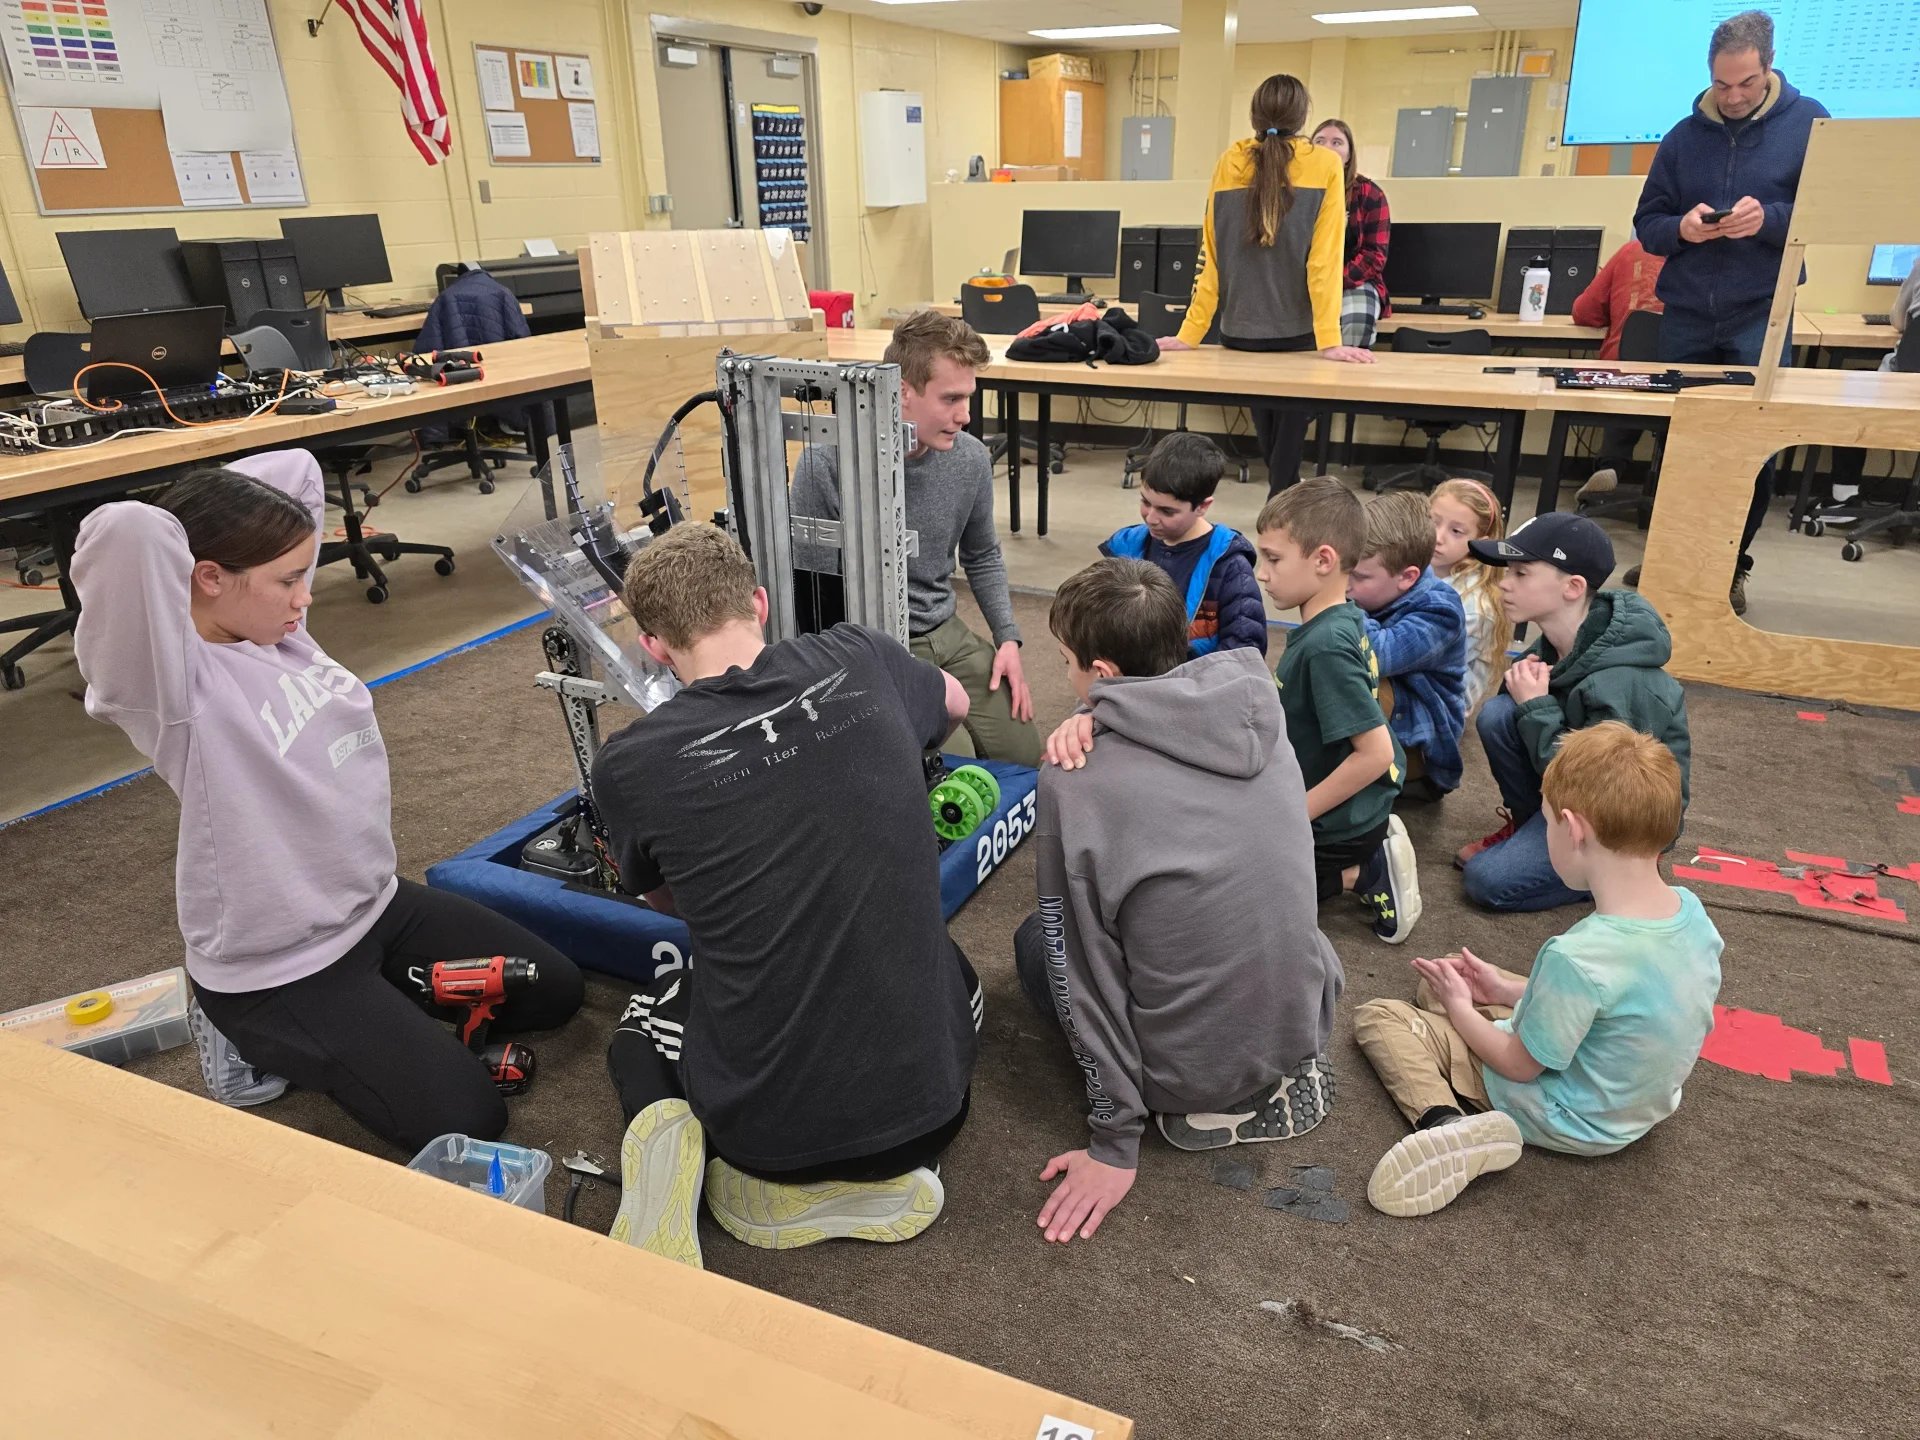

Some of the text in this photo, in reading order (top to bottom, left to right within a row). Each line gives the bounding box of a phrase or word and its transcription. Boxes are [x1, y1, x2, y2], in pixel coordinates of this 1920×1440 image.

[56, 124, 62, 132] V
[54, 148, 81, 156] I R
[762, 745, 799, 767] Tier
[976, 788, 1036, 885] 2053
[652, 940, 694, 980] 2
[1, 1014, 36, 1027] HEAT
[39, 1006, 64, 1018] SHR
[112, 988, 133, 998] ING
[136, 982, 155, 992] KIT
